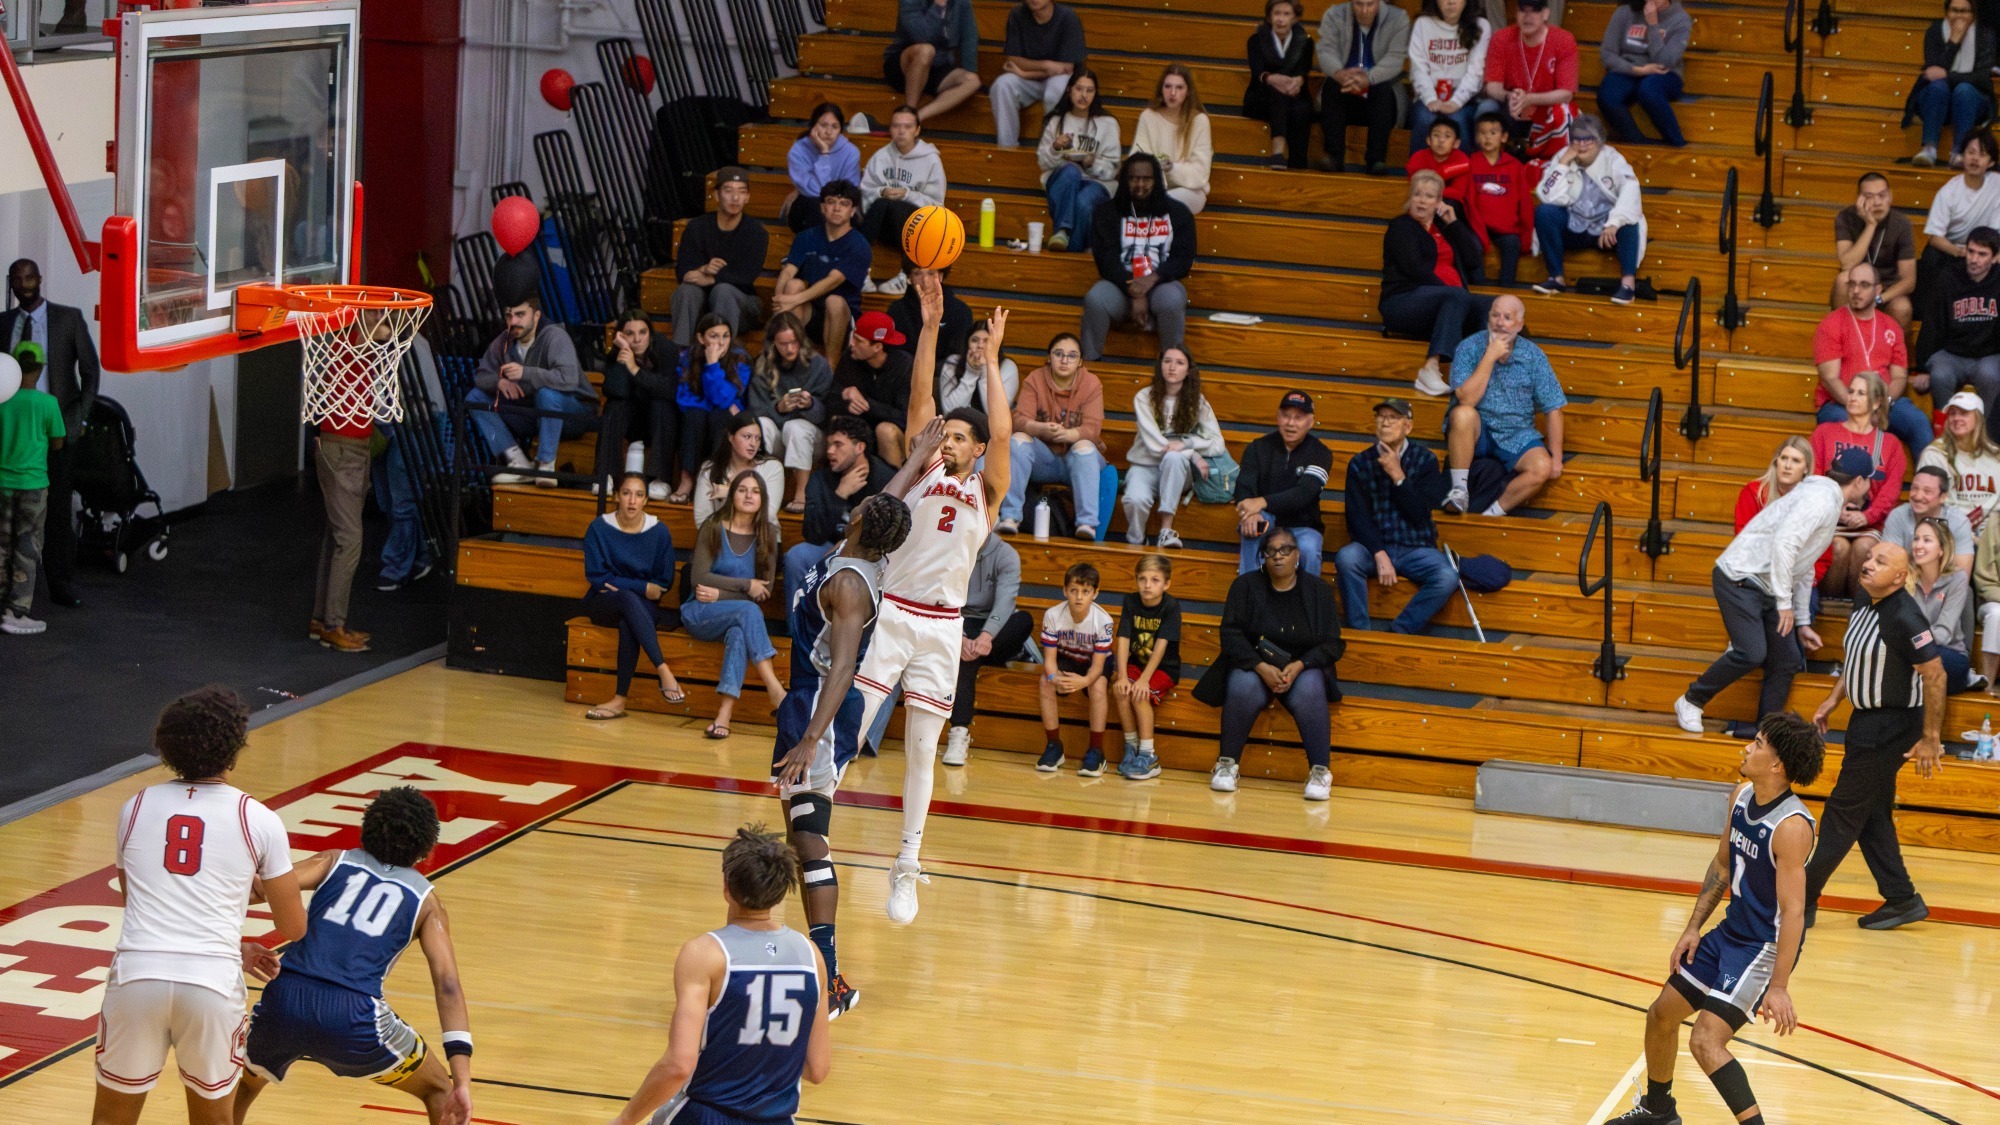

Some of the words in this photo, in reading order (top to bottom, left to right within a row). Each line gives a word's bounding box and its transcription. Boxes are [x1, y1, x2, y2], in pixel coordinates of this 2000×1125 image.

[1127, 221, 1168, 237] Broolyn
[920, 482, 979, 513] AGLE
[1954, 474, 1997, 494] IOLA
[937, 505, 957, 533] 2
[163, 814, 205, 877] 8
[322, 870, 404, 938] 10
[738, 973, 806, 1047] 15
